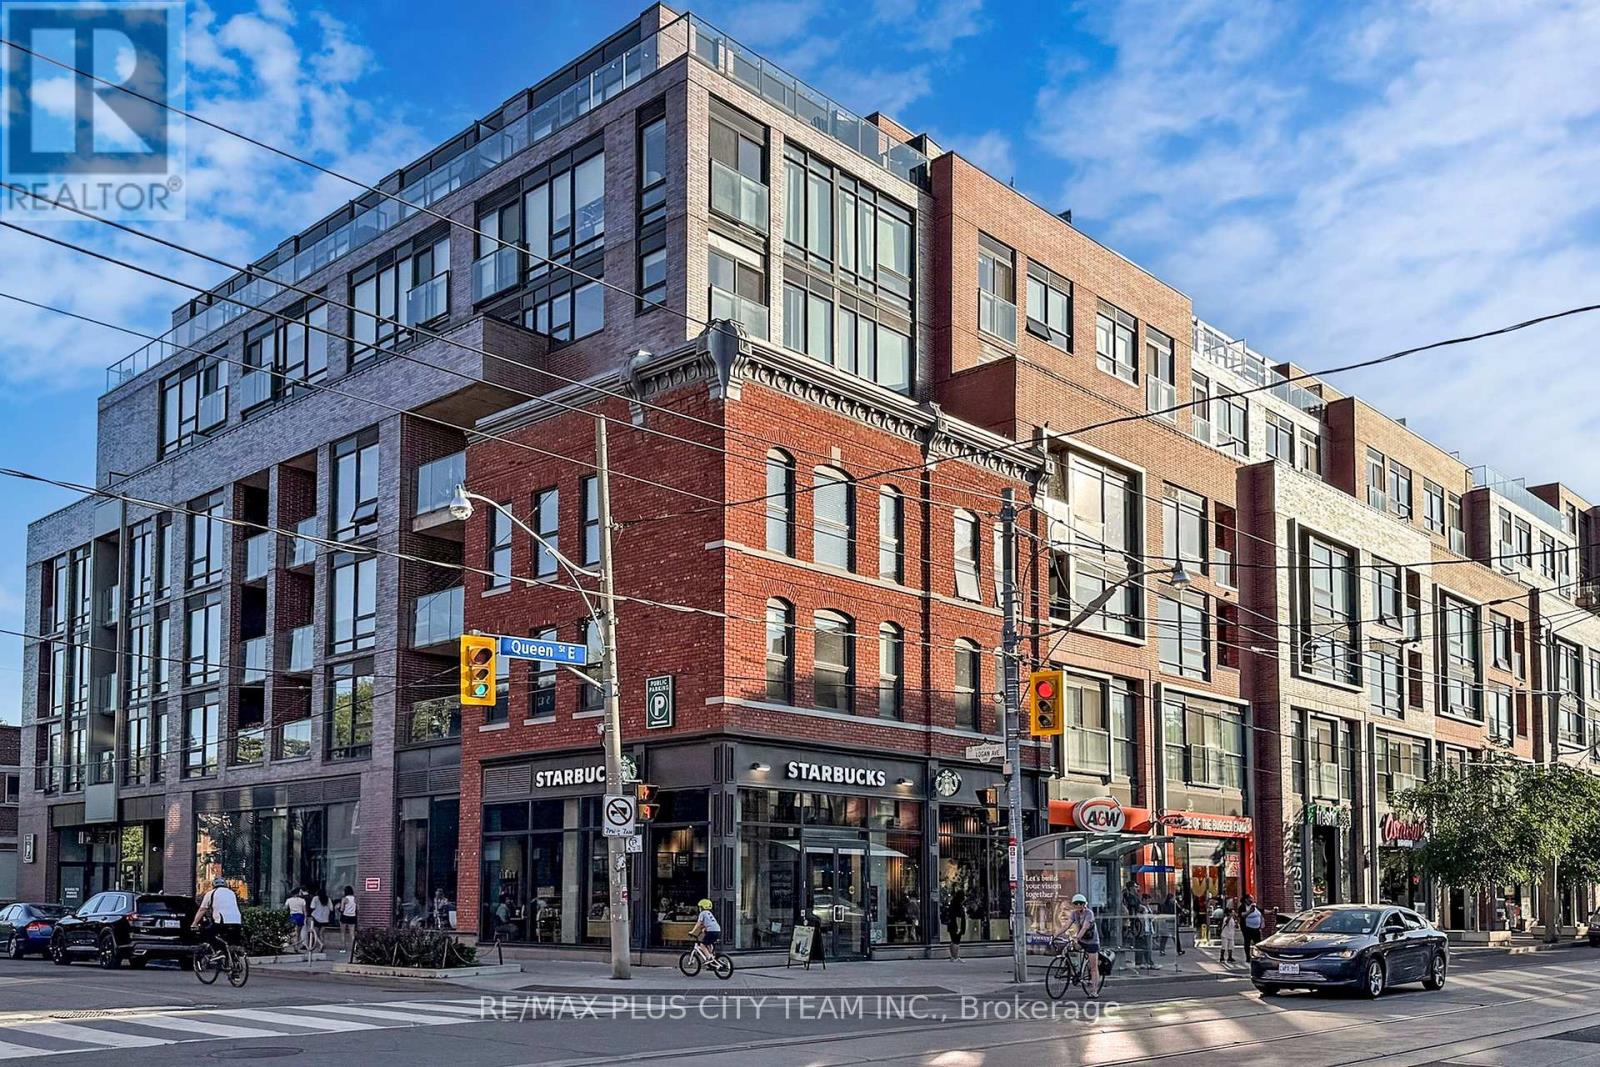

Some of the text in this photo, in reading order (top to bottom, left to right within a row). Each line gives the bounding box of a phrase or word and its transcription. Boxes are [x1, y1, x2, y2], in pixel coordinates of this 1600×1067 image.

[511, 640, 576, 660] Queen St E
[535, 765, 606, 788] STARBUC
[788, 761, 886, 787] STARBUCKS
[1087, 810, 1121, 828] A&W
[1025, 874, 1040, 882] Let's
[1041, 882, 1062, 890] vision
